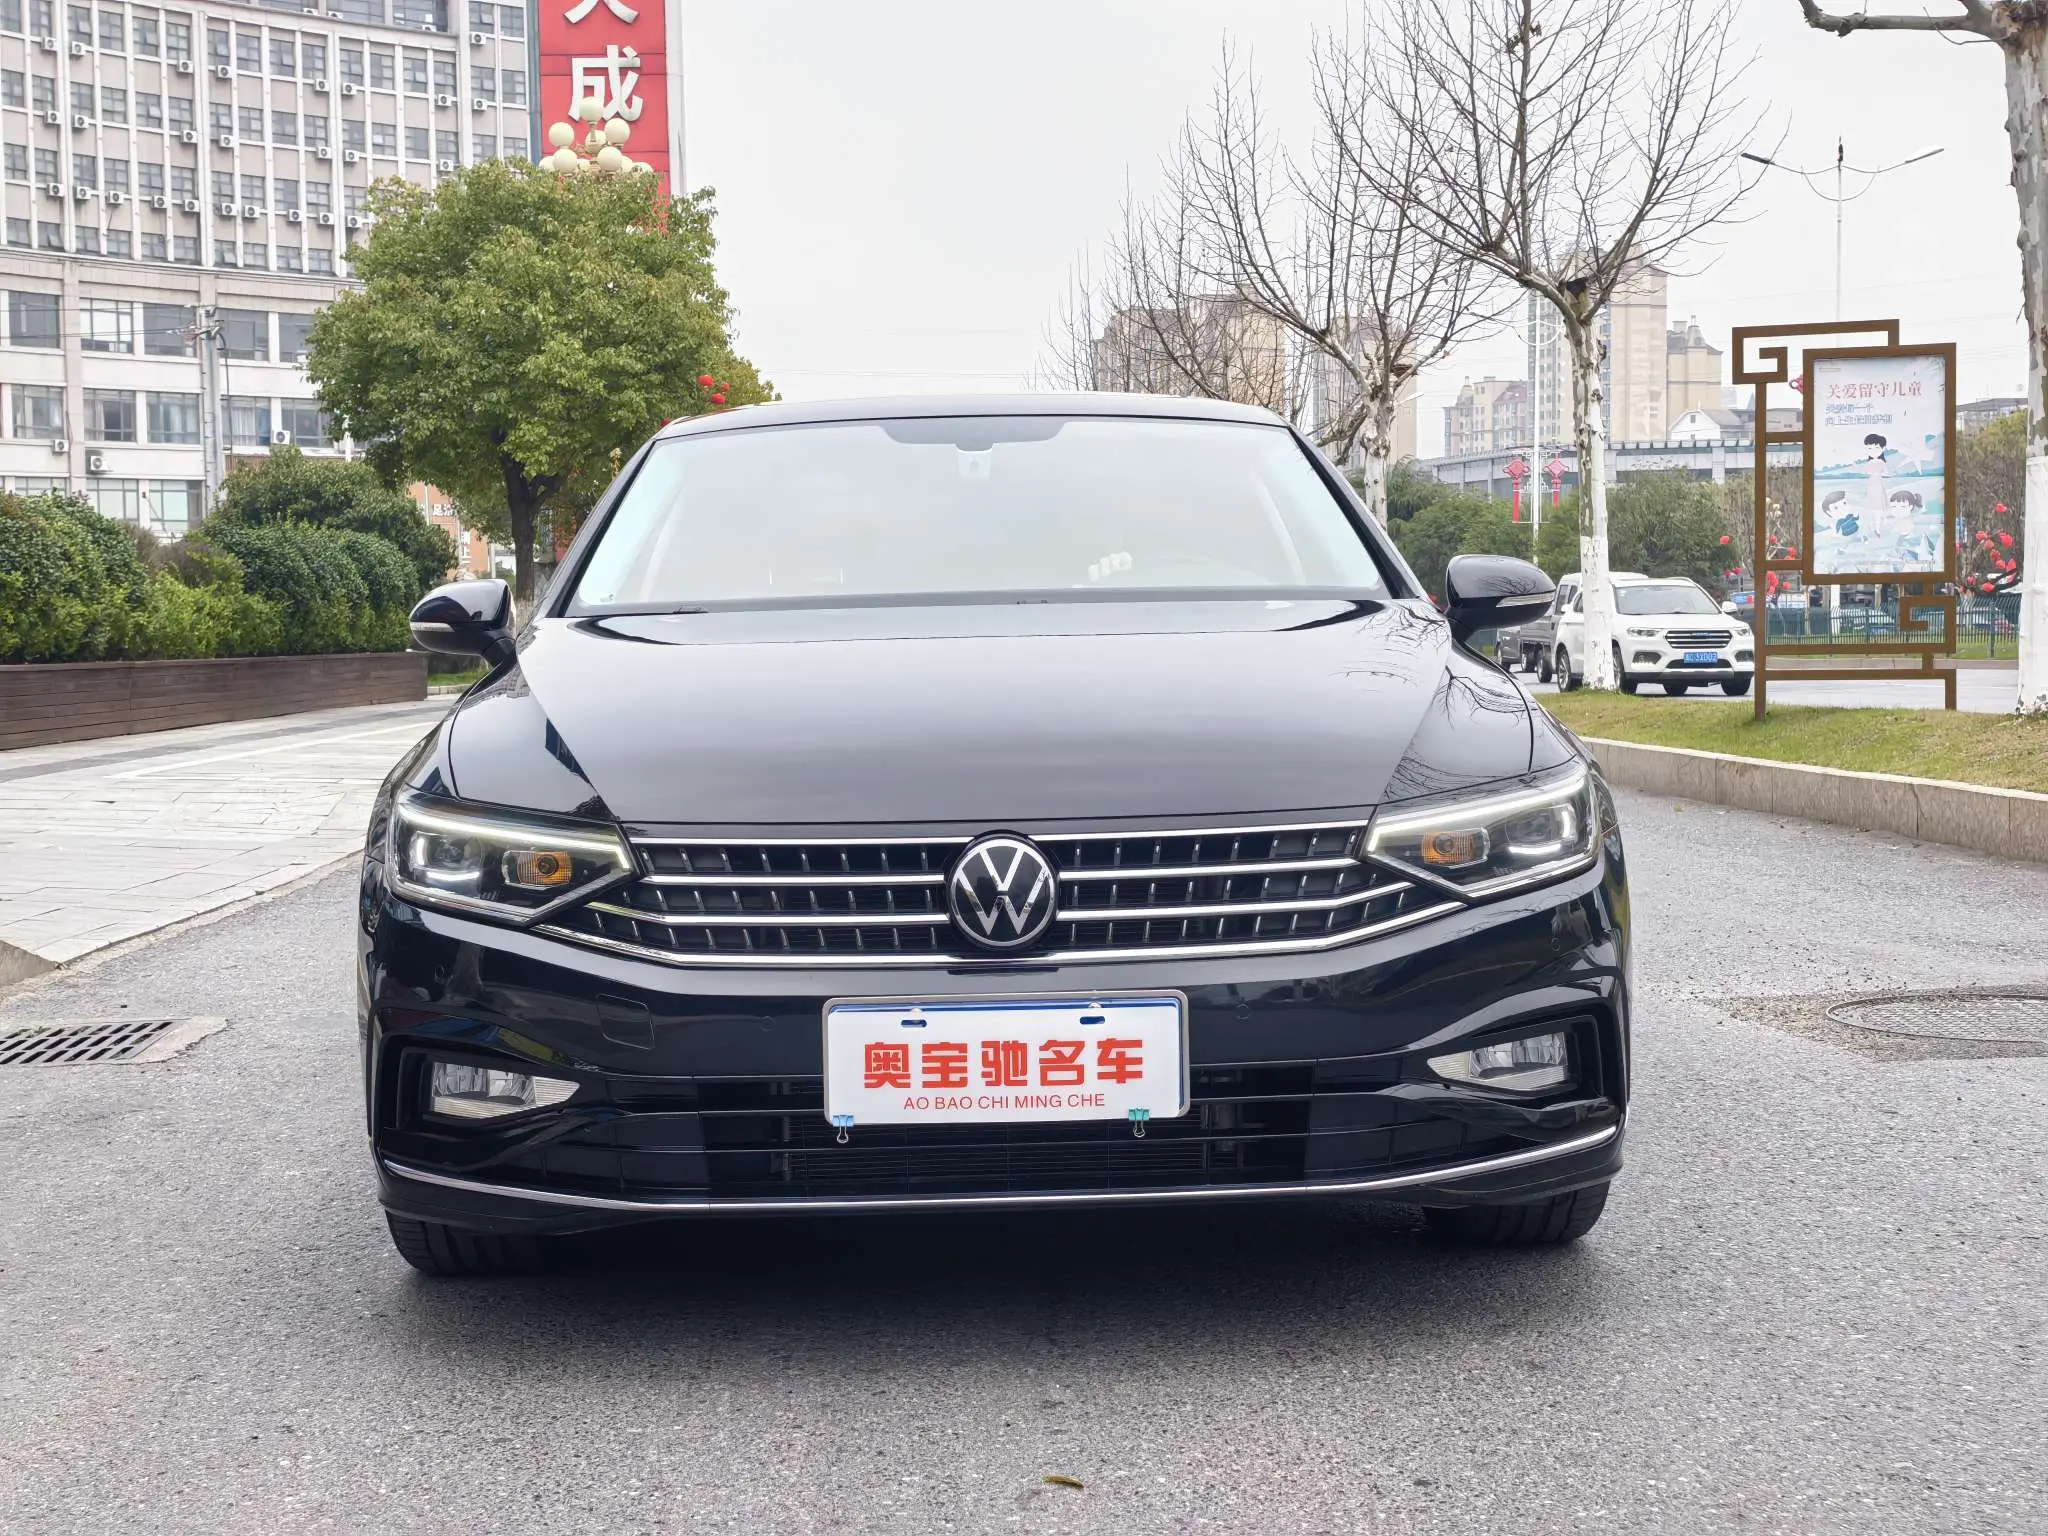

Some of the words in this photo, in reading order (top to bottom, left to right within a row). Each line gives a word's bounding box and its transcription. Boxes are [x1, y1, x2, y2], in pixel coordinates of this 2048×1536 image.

[564, 0, 643, 122] 成
[1828, 381, 1922, 399] 关爱留守儿童
[864, 1037, 1144, 1090] 奥宝驰名车
[904, 1096, 930, 1110] AO
[934, 1095, 975, 1110] BAO
[977, 1095, 1009, 1109] CHI
[1014, 1094, 1062, 1108] MING
[1066, 1093, 1105, 1107] CHE
